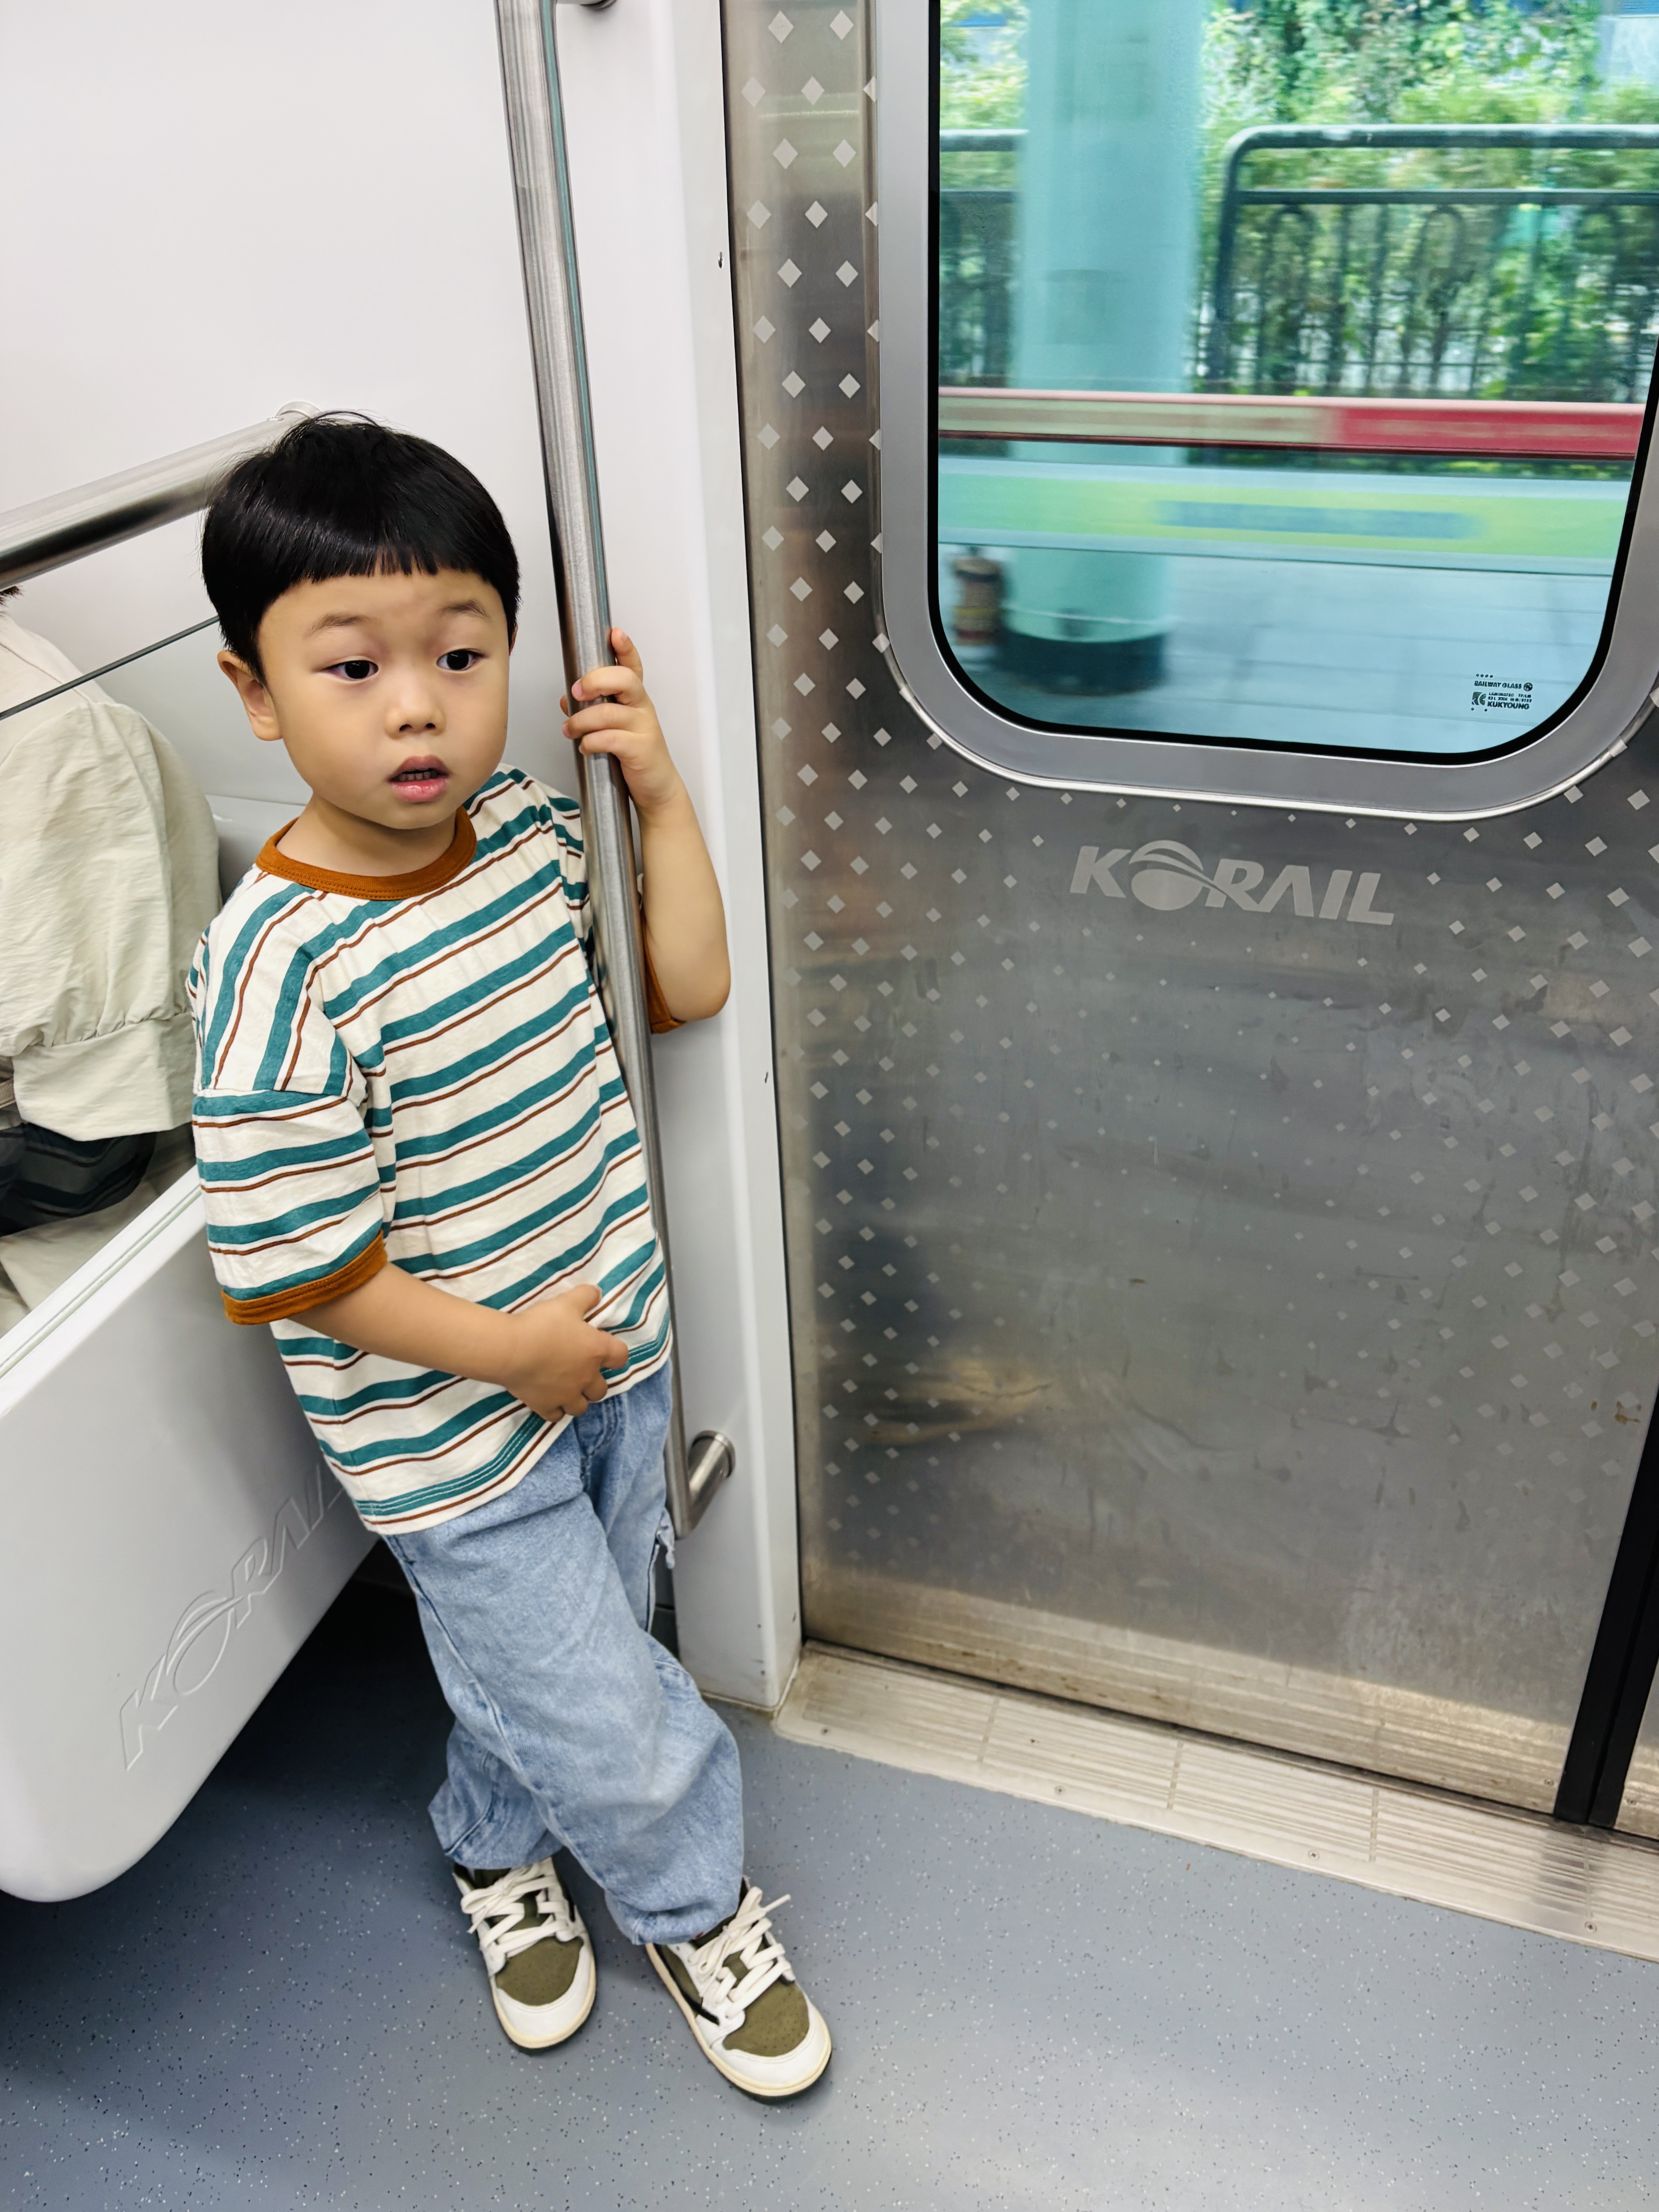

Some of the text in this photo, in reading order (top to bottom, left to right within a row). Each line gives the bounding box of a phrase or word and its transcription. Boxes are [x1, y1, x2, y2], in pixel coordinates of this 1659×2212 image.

[1487, 701, 1530, 710] KUKYOUNG
[1069, 839, 1394, 925] KORAIL
[119, 1463, 344, 1771] KORAI
